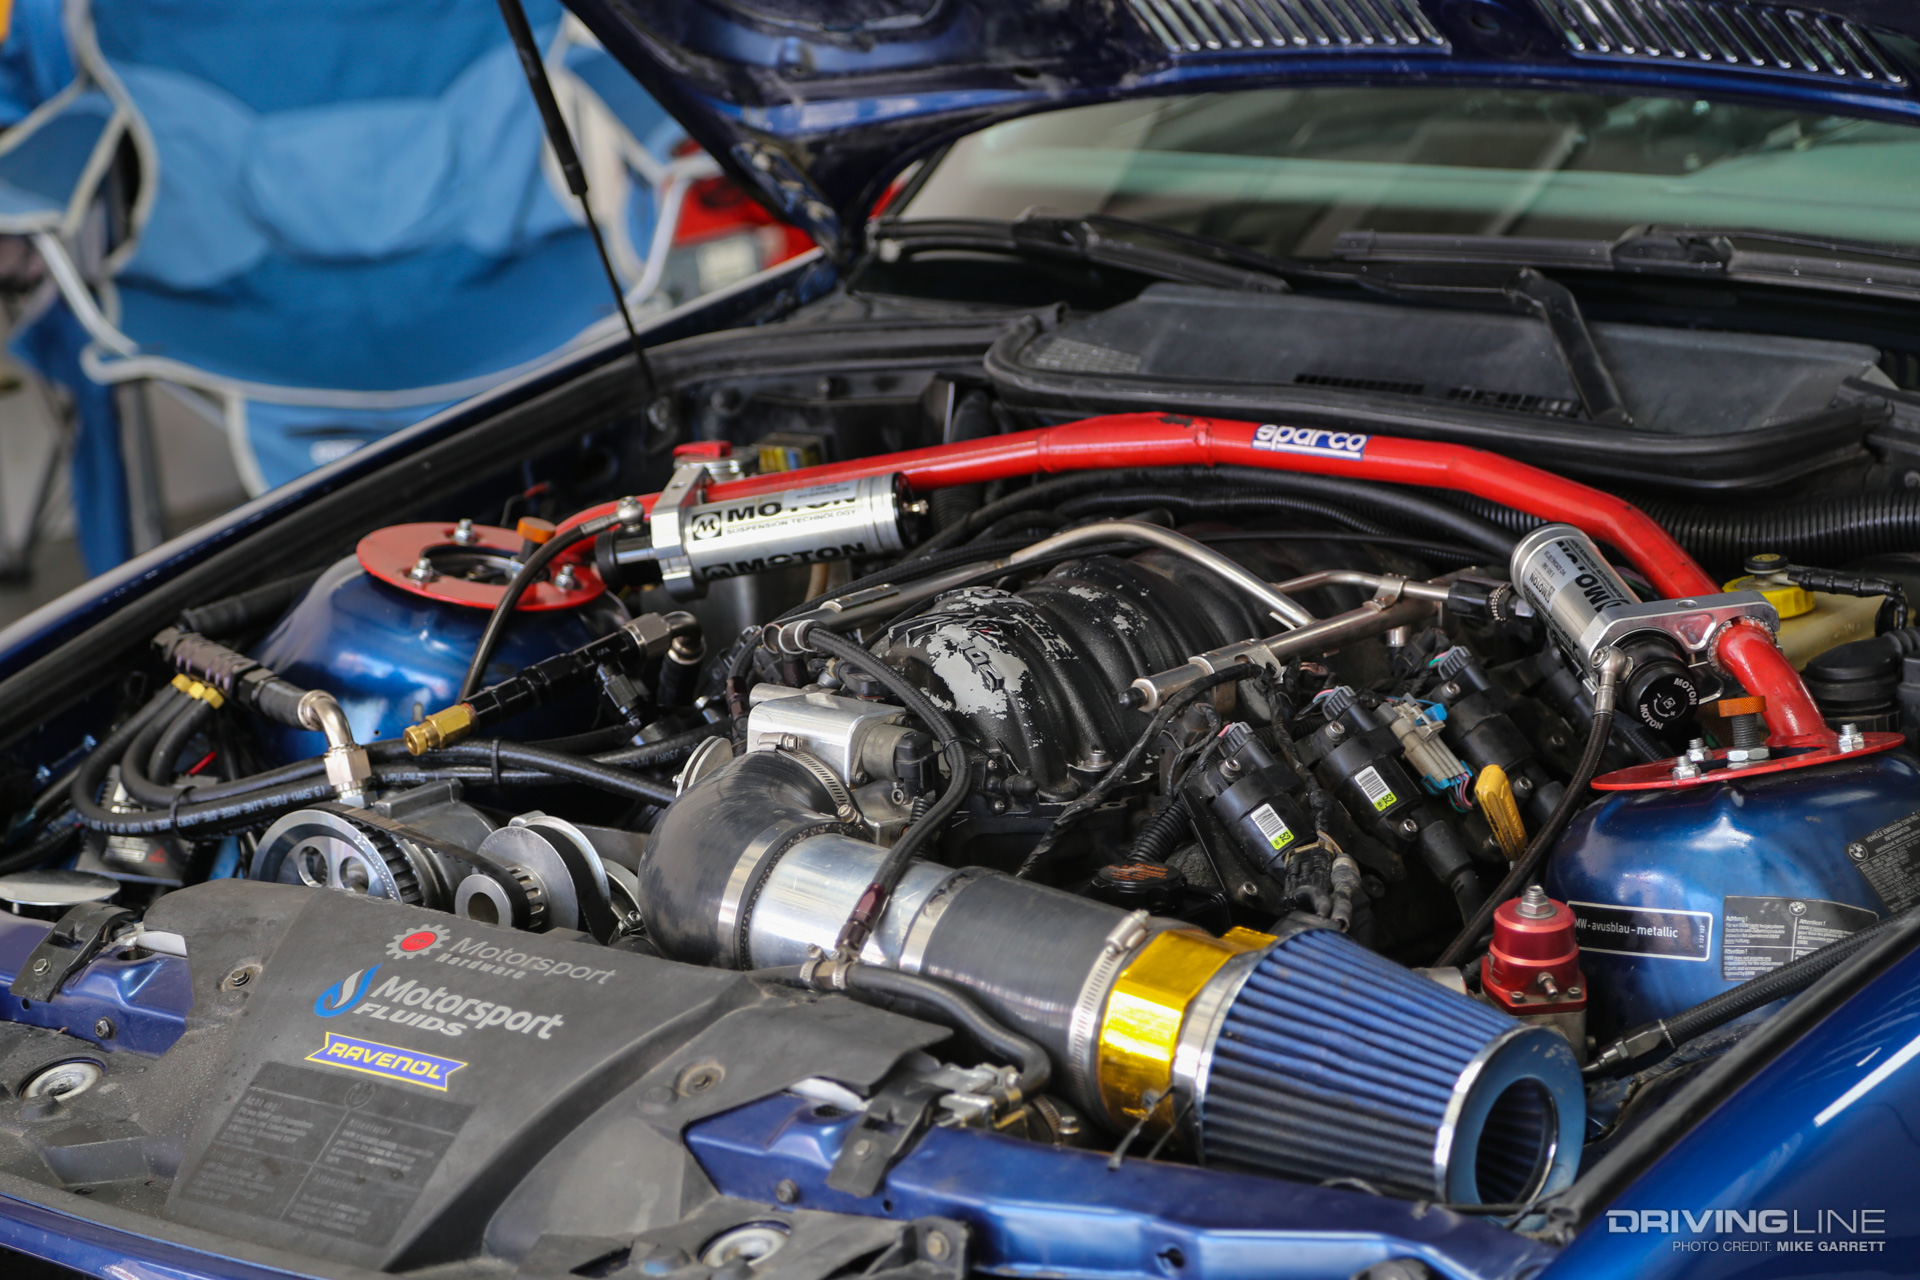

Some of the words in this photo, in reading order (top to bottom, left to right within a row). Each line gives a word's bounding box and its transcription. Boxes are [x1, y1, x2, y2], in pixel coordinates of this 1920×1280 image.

[1256, 424, 1367, 451] sparco
[726, 520, 788, 534] SUSPENSION
[791, 508, 857, 525] TECHNOLOGY
[1529, 572, 1548, 598] MOTON
[1674, 678, 1697, 705] MOTON
[1640, 704, 1664, 730] MOTON
[270, 795, 288, 807] FUEL
[1382, 793, 1394, 804] 52
[1279, 831, 1291, 842] 52
[1865, 830, 1883, 842] VEHICLE
[1882, 822, 1902, 834] EMISSION
[1575, 918, 1679, 938] MW-avusblau-metallic
[435, 953, 527, 980] Hardware
[449, 937, 617, 985] Motorsport
[354, 1003, 467, 1037] FLUIDS
[369, 975, 564, 1040] Motorsport
[327, 1042, 442, 1080] RAVENOL
